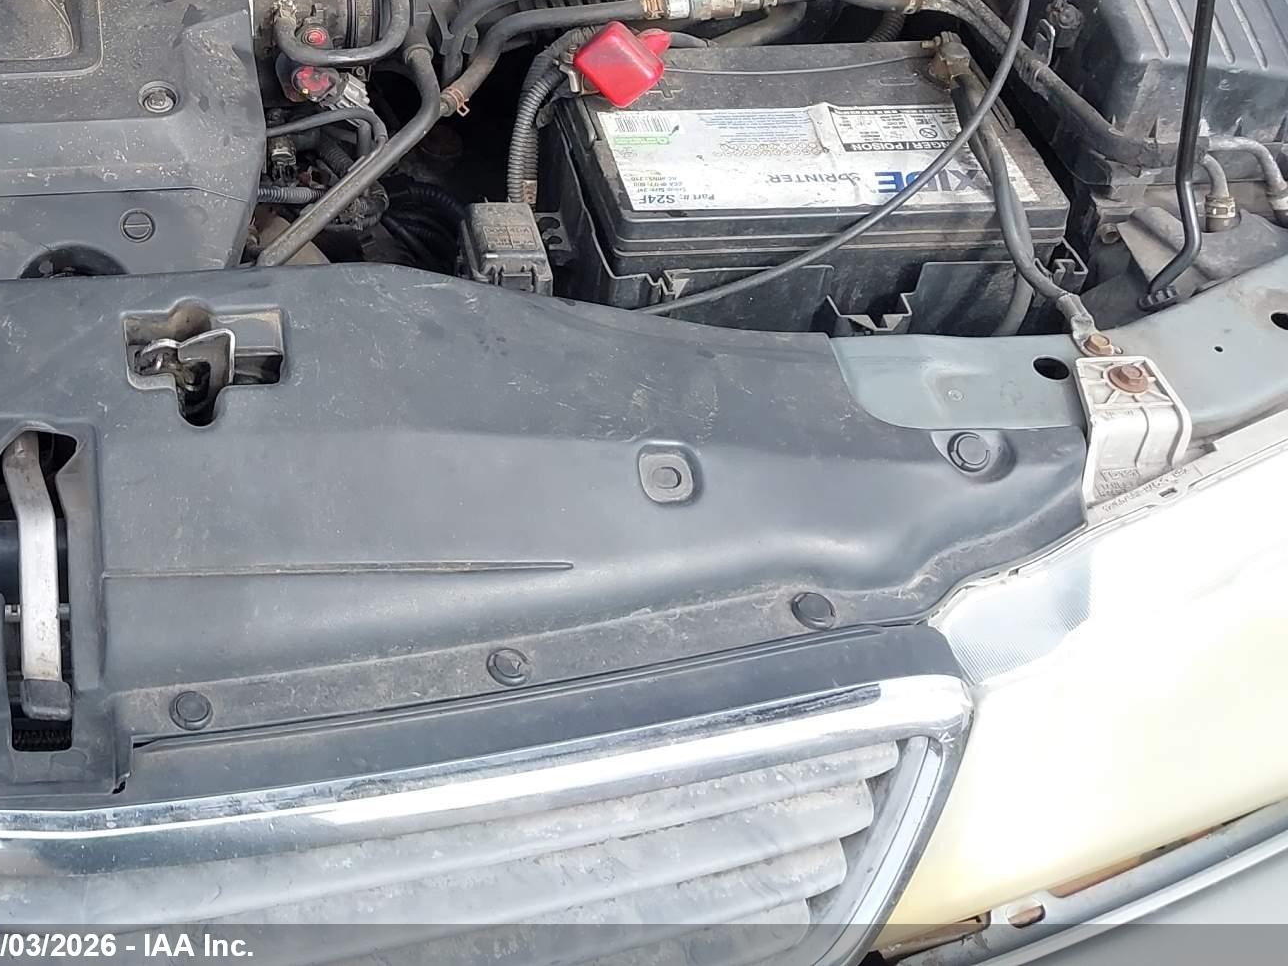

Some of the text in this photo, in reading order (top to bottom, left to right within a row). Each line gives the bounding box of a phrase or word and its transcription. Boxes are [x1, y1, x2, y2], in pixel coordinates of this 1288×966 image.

[851, 142, 904, 152] POISON
[874, 170, 987, 193] XIDE
[639, 194, 676, 204] S24F
[692, 193, 715, 201] Part
